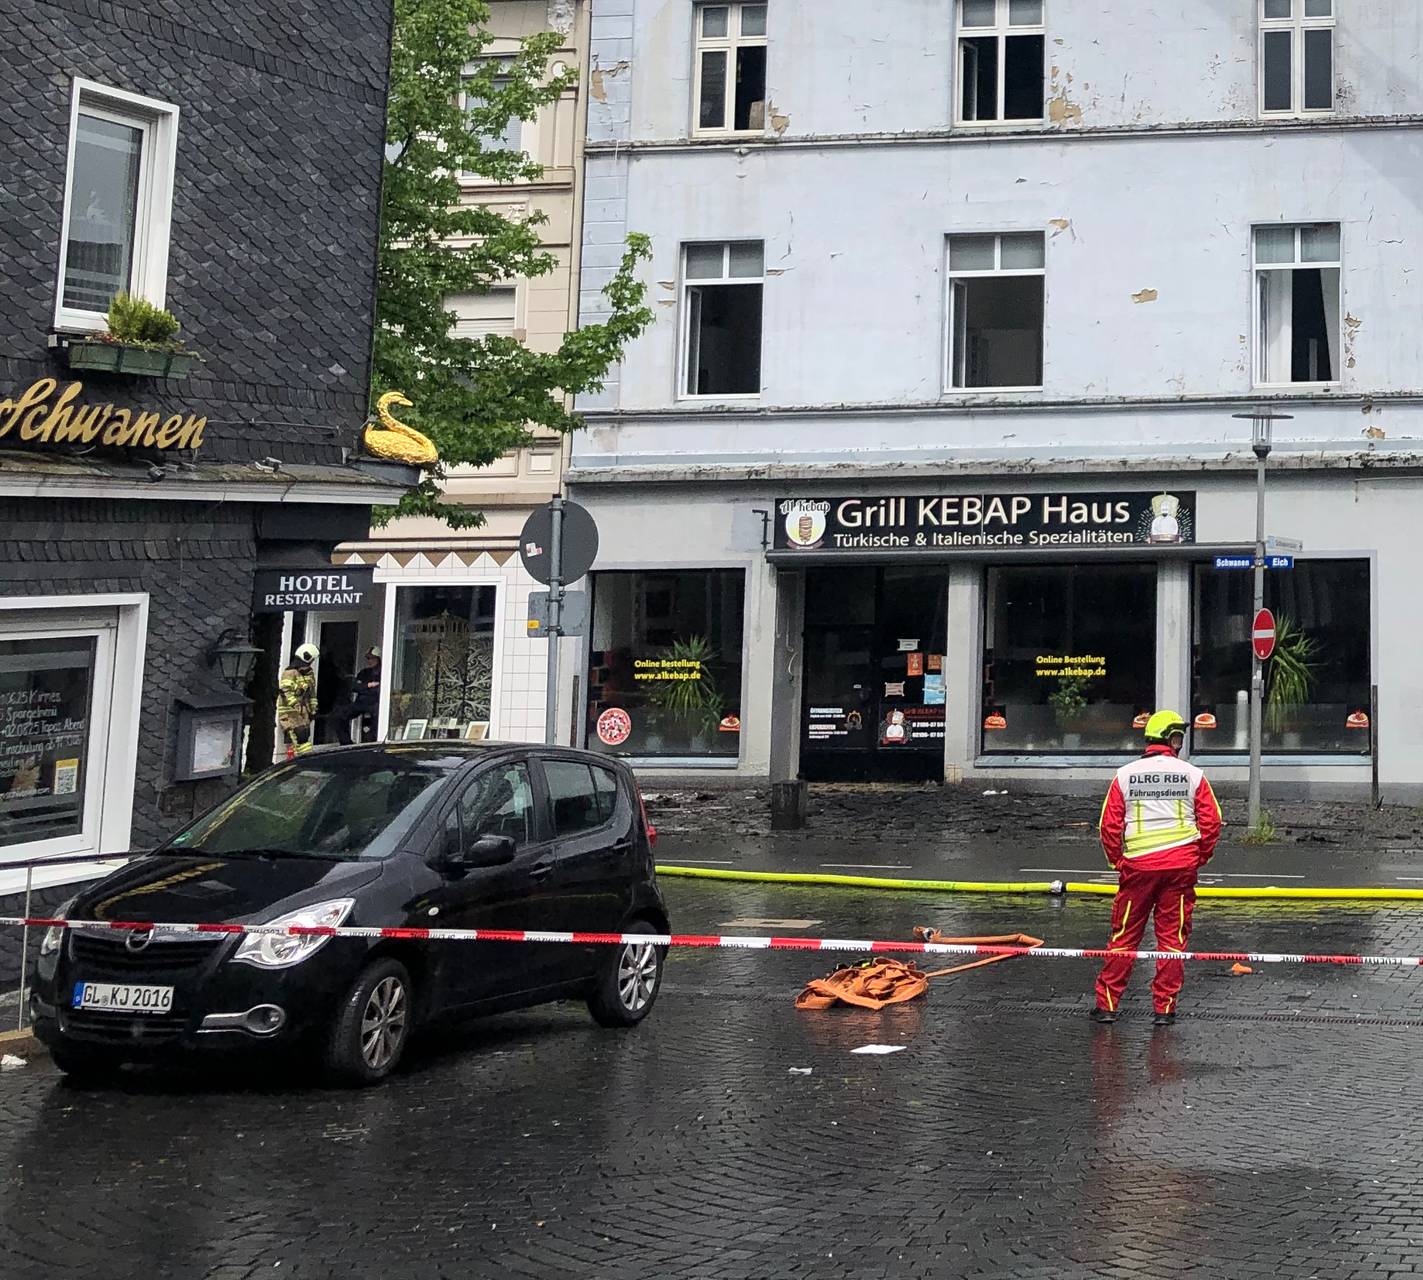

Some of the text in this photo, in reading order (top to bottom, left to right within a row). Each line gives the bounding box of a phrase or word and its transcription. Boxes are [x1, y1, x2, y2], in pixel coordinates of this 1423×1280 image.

[796, 499, 831, 515] Kebap
[836, 495, 1130, 527] Grill KEBAP Haus
[834, 529, 1134, 547] Türkische & Italienische Spezialitäten
[280, 575, 354, 592] HOTEL
[265, 592, 363, 606] RESTAURANT
[634, 658, 701, 669] Online Bestellung
[1036, 654, 1106, 666] Online Bestellung
[634, 670, 701, 681] www.a1kebap.de
[1036, 667, 1106, 678] www.a1kebap.de
[1129, 774, 1188, 784] DLRG RBK
[1129, 788, 1188, 798] Führungsdienst
[83, 985, 171, 1008] GL KJ 2016
